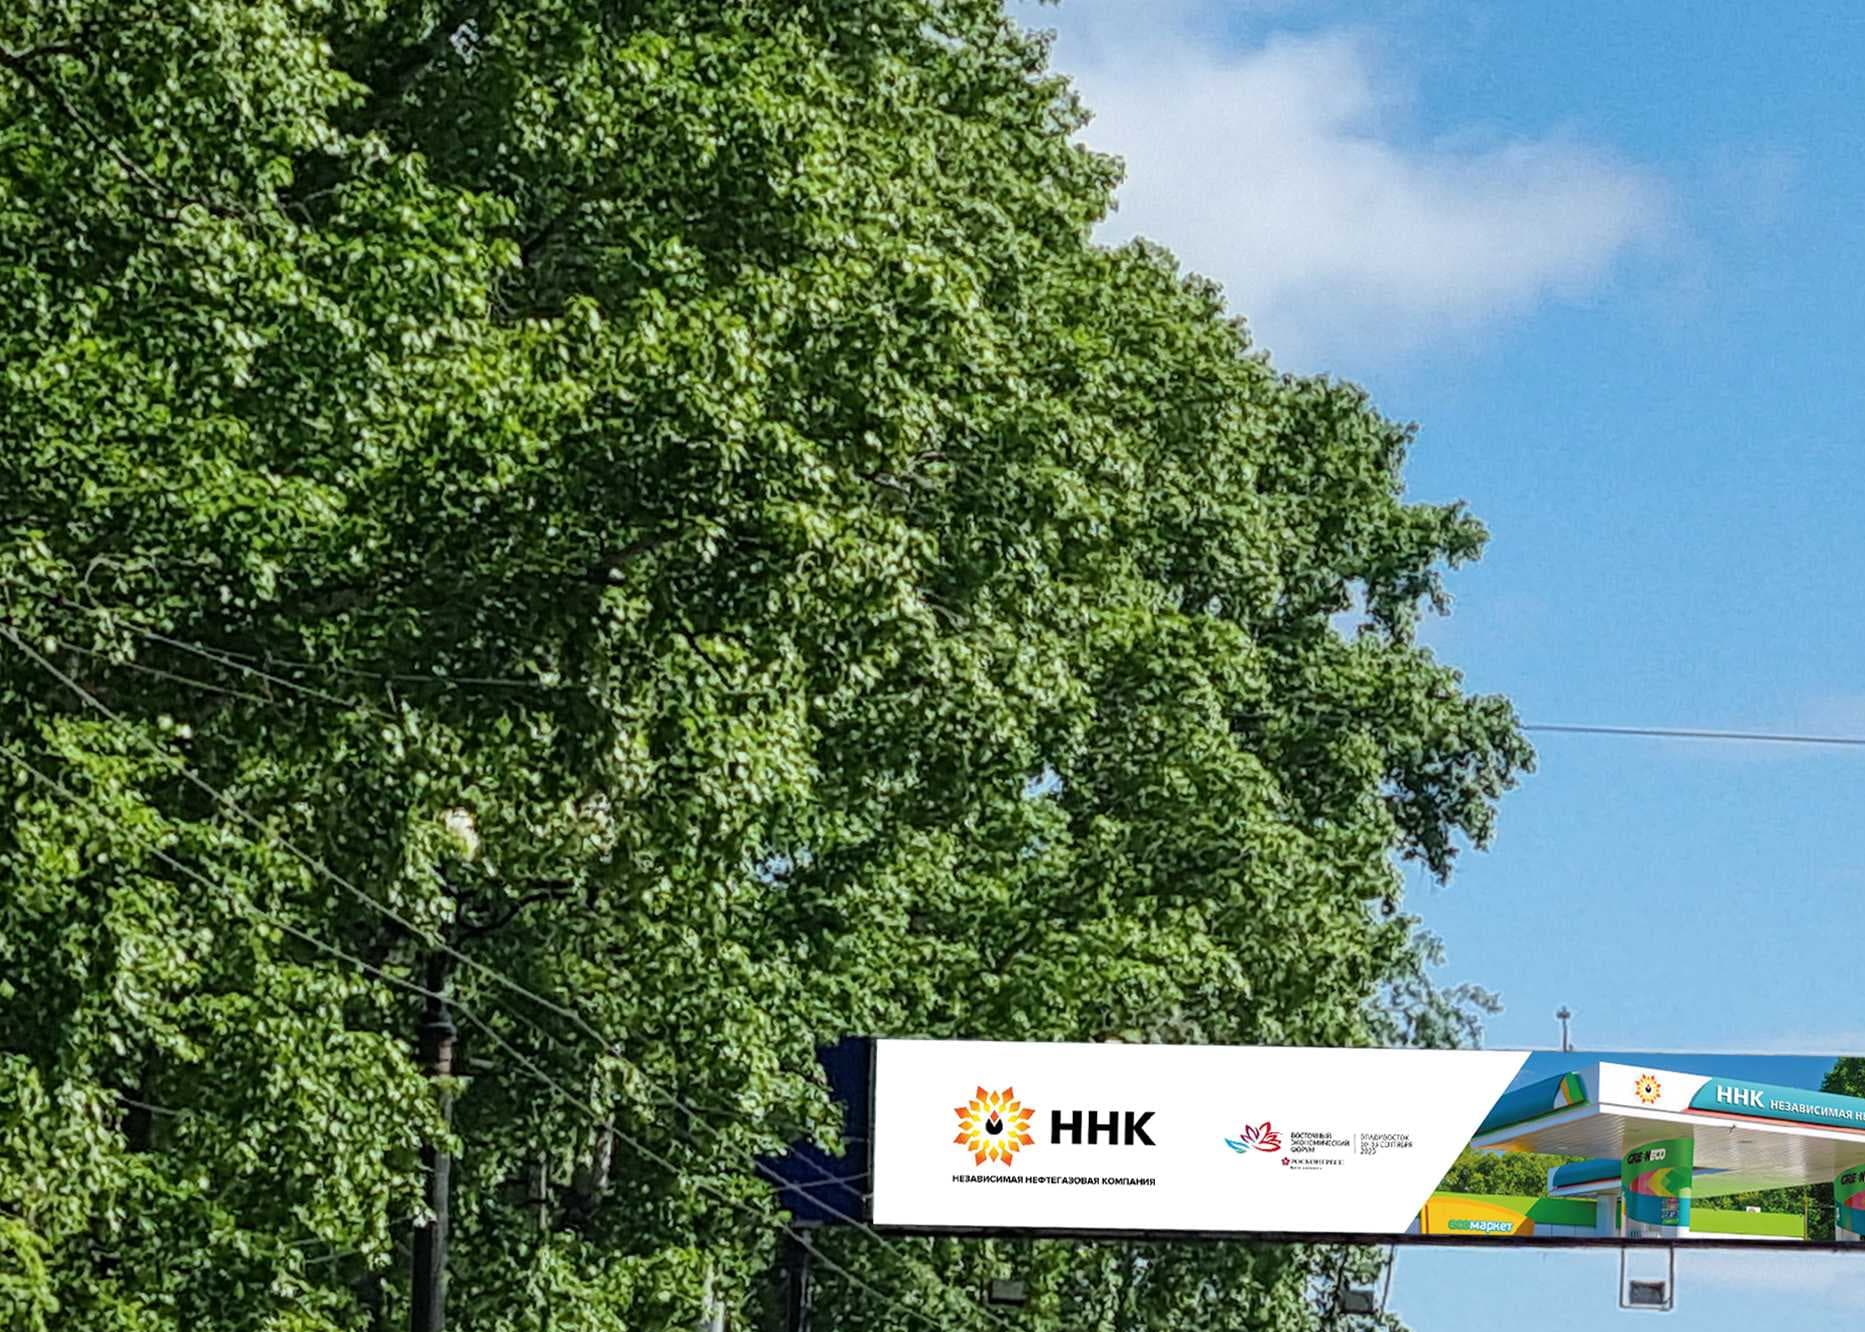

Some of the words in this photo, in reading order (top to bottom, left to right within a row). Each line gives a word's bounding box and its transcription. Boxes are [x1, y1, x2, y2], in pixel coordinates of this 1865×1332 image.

[1716, 1084, 1764, 1109] ННК
[1770, 1099, 1853, 1120] НЕЗАВИСИМАЯ
[1051, 1109, 1157, 1146] ННК
[952, 1175, 1023, 1184] НЕЗАВИСИМАЯ
[1025, 1176, 1100, 1185] НЕФТЕГАЗОВАЯ
[1102, 1177, 1156, 1186] КОМПАНИЯ
